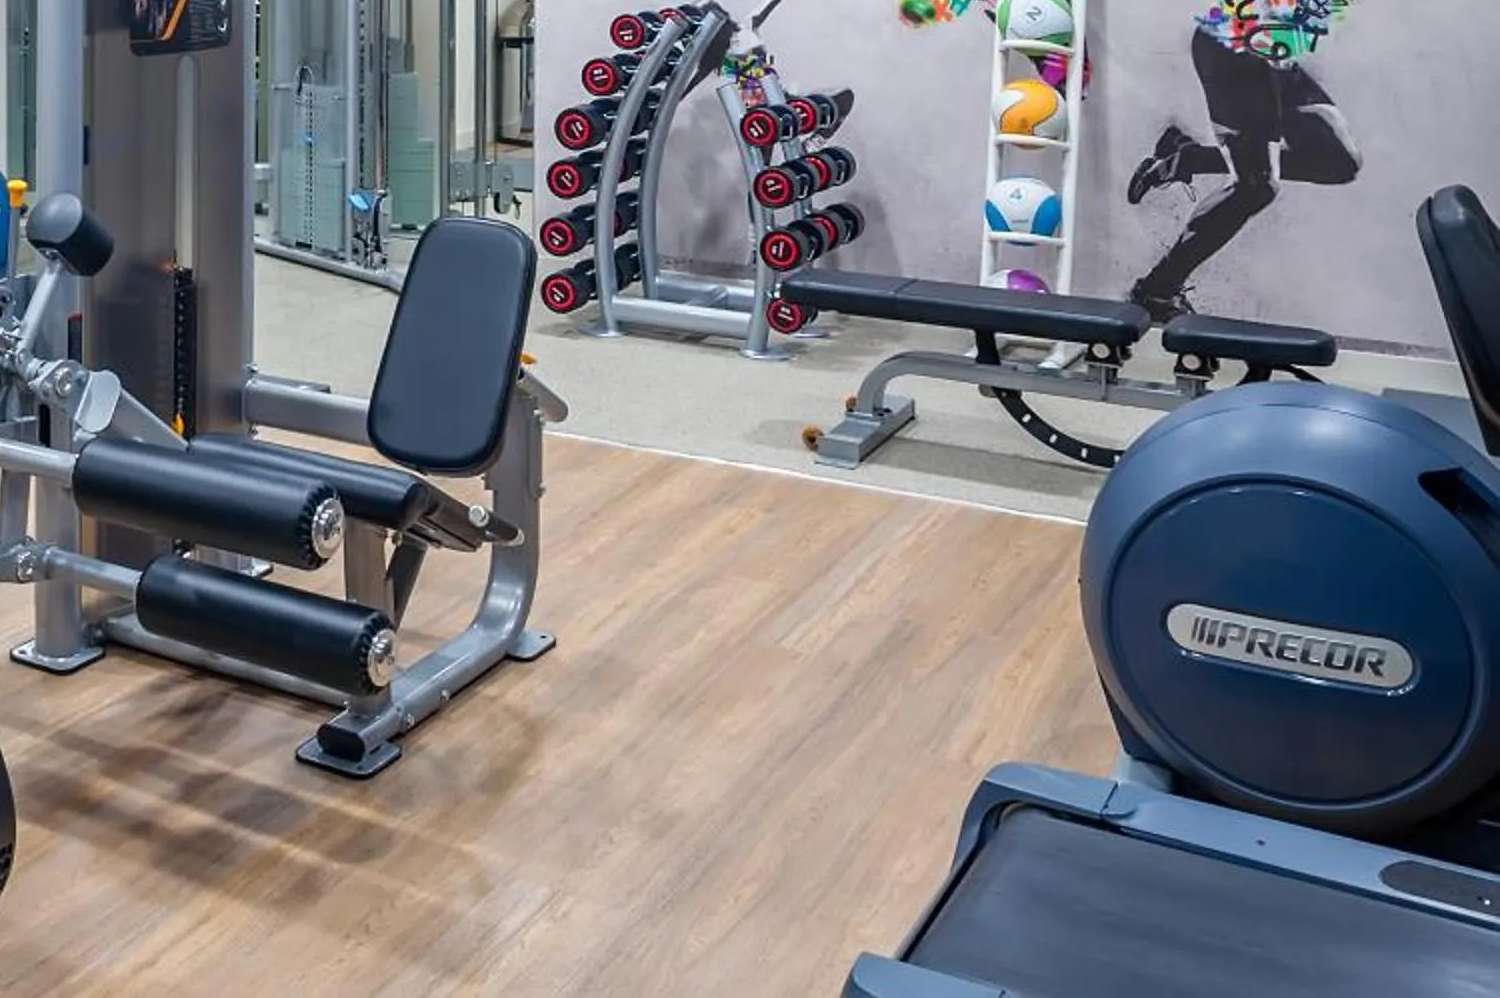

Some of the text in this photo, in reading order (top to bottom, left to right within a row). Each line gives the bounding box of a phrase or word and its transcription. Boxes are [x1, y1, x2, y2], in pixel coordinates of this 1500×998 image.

[1025, 5, 1043, 22] 2
[1008, 187, 1023, 201] 4
[1215, 619, 1388, 679] PRECOR
